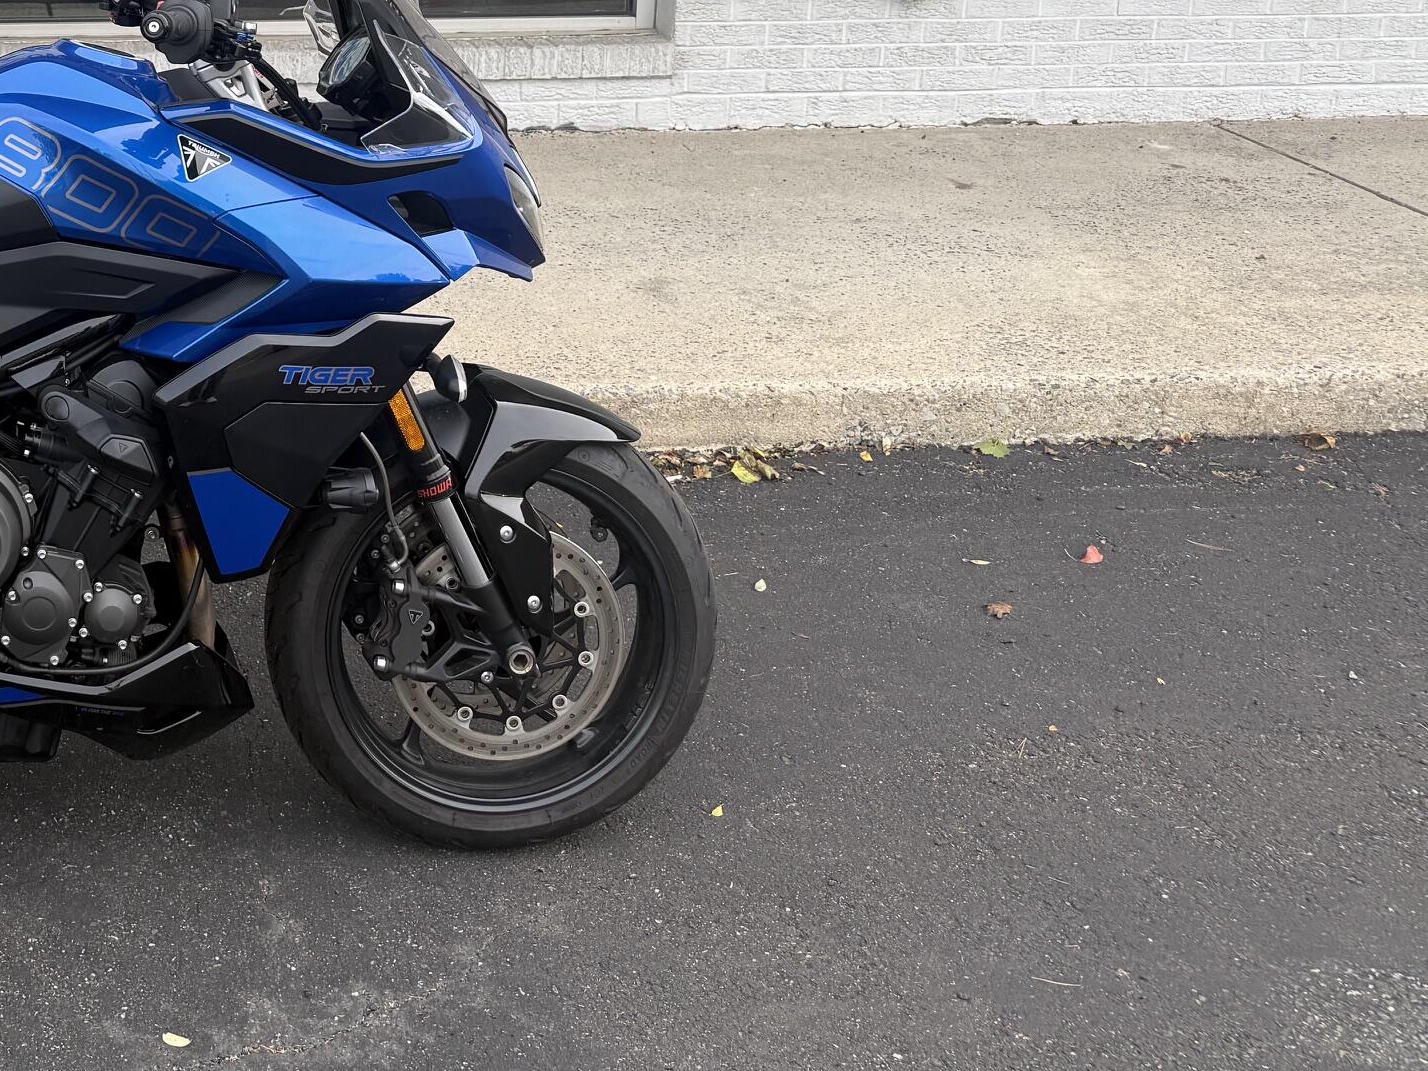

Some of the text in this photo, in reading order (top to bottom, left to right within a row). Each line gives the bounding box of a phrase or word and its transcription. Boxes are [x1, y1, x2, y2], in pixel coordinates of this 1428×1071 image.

[188, 140, 221, 159] TRIUMPH
[278, 364, 375, 385] TIGER
[304, 385, 386, 394] SPORT
[417, 476, 453, 498] SHOWA
